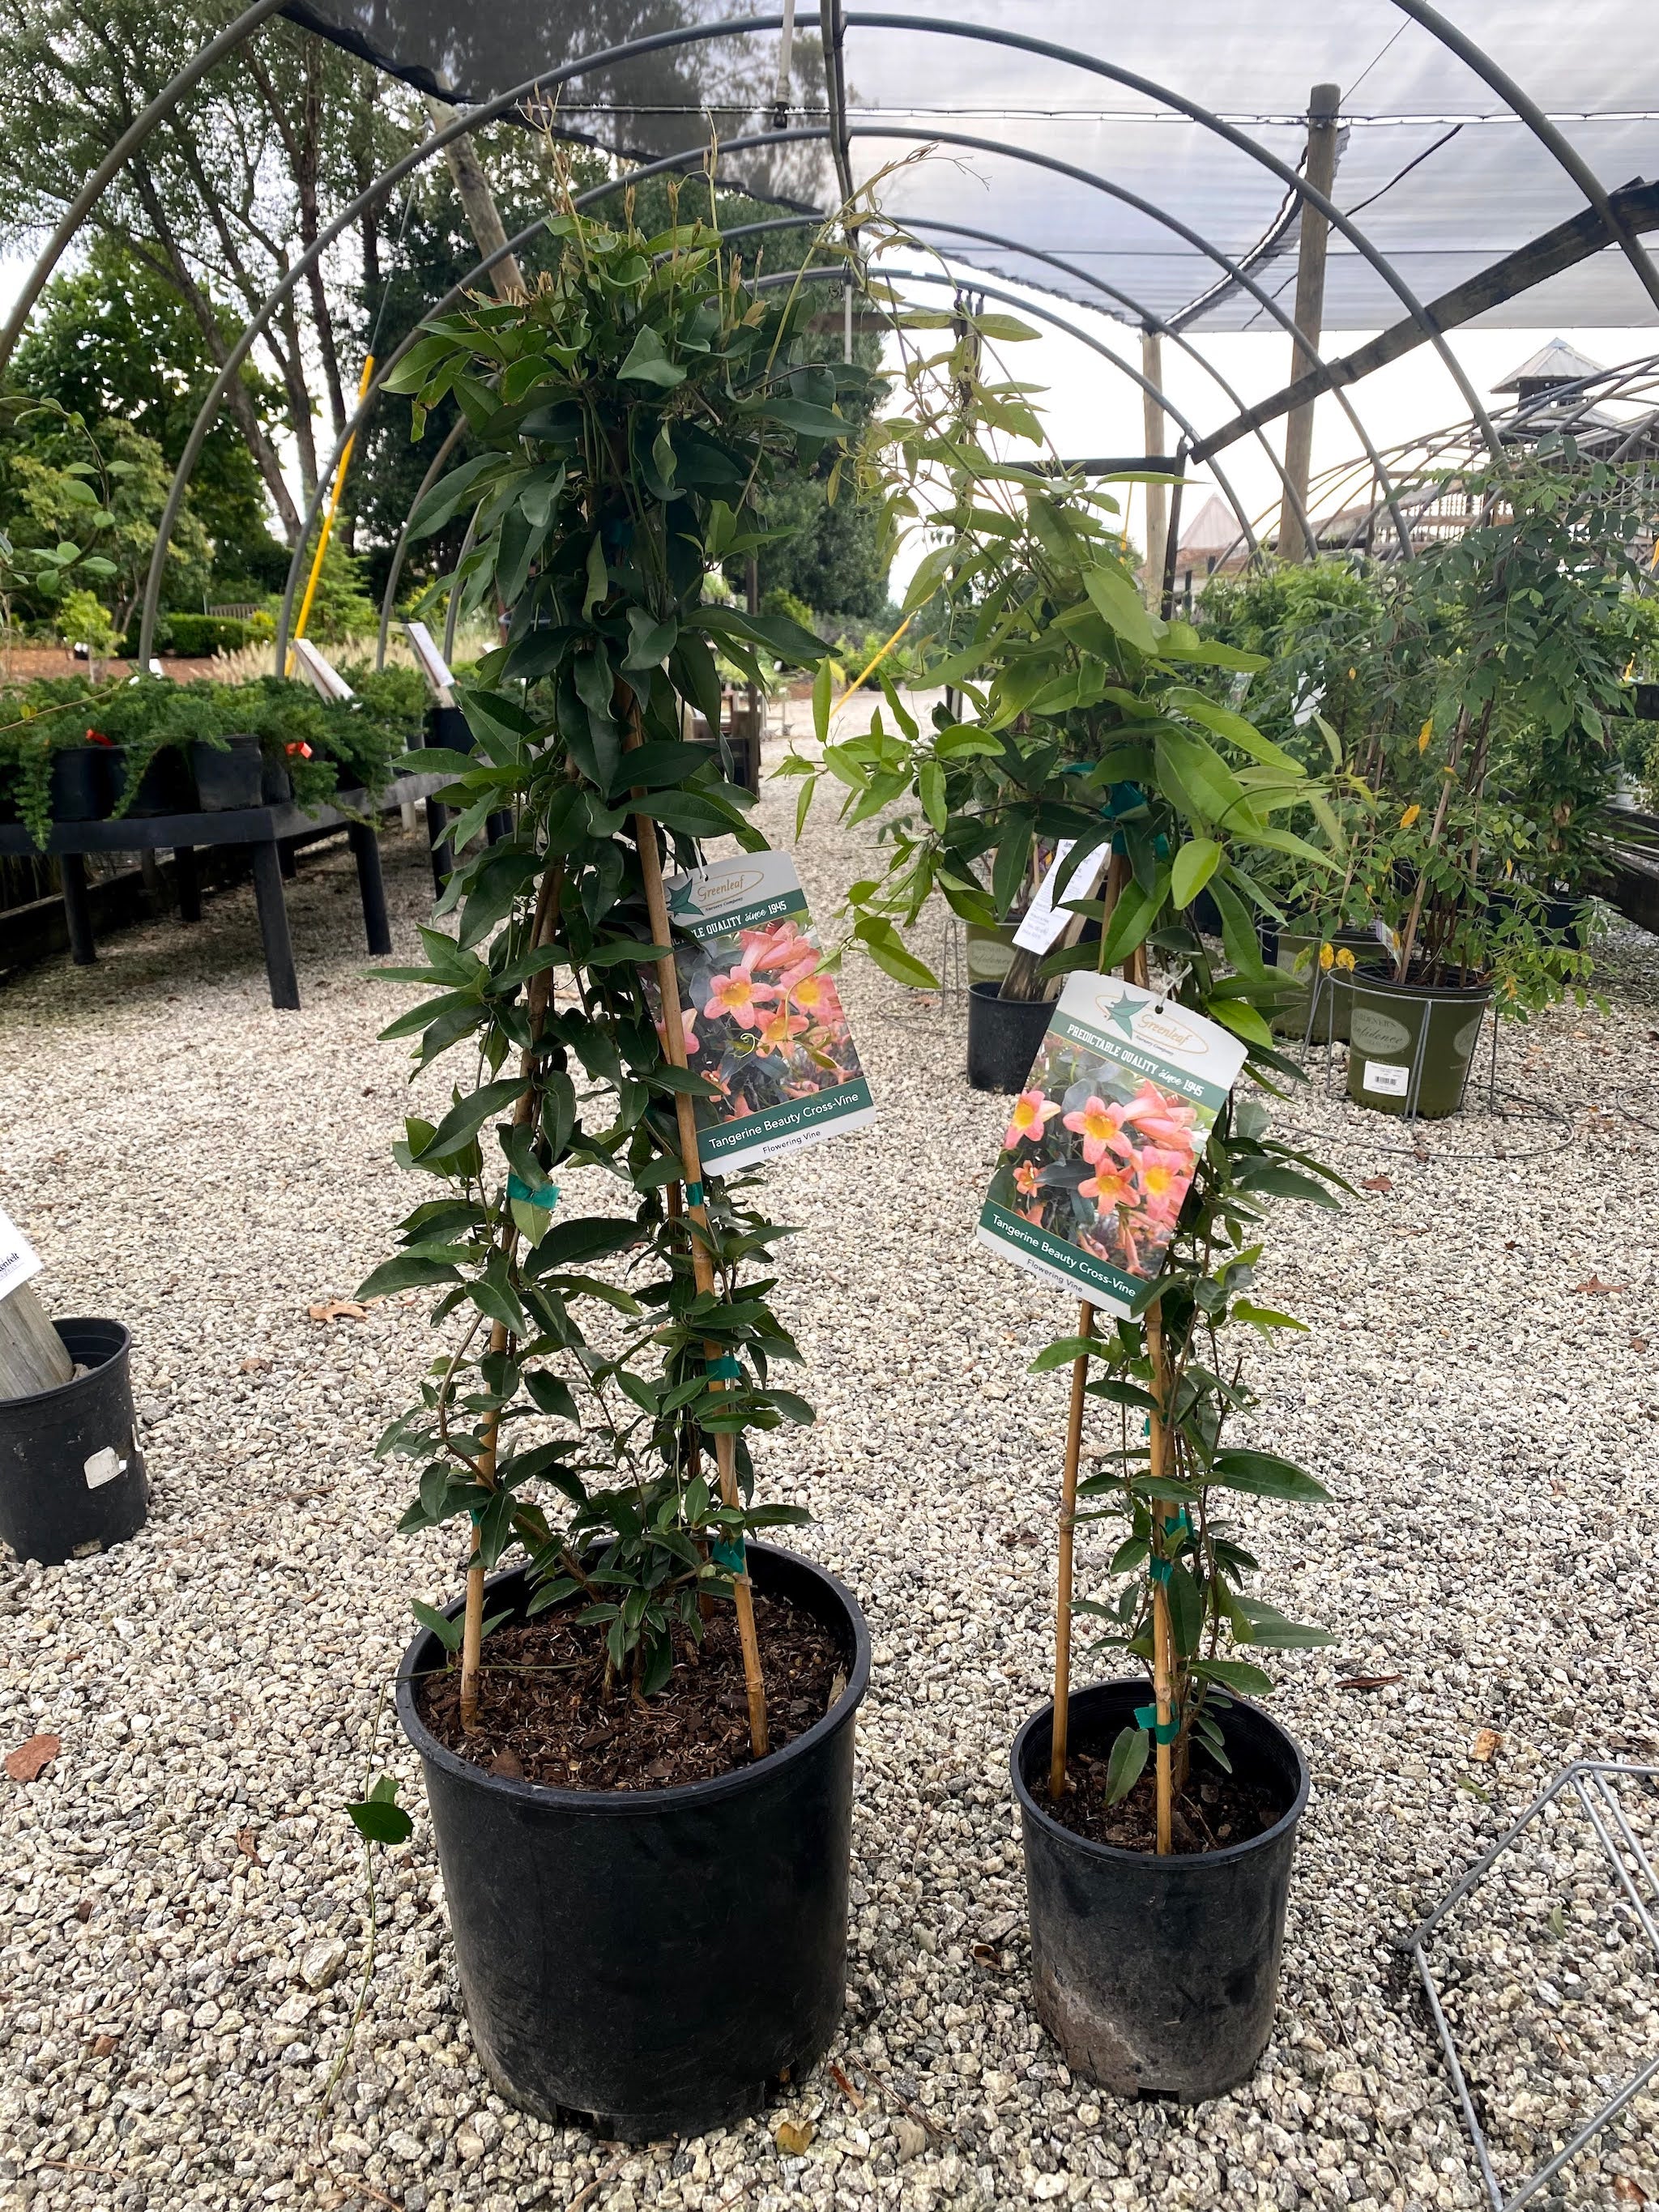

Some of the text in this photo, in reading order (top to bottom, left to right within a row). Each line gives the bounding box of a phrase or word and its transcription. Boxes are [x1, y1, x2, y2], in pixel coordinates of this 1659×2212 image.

[697, 875, 744, 901] Greenleaf
[723, 897, 744, 906] Company
[706, 901, 787, 935] QUALITY since 1945
[1137, 1013, 1193, 1046] Greenleaf
[1066, 1024, 1205, 1097] PREDICTABLE QUALITY since 1945
[709, 1093, 859, 1149] Tangerine Beauty Cross-Vine
[762, 1129, 821, 1153] Flowering Vine
[992, 1213, 1136, 1298] Tangerine Beauty Cross-Vine
[1026, 1259, 1083, 1293] Flowering Vine
